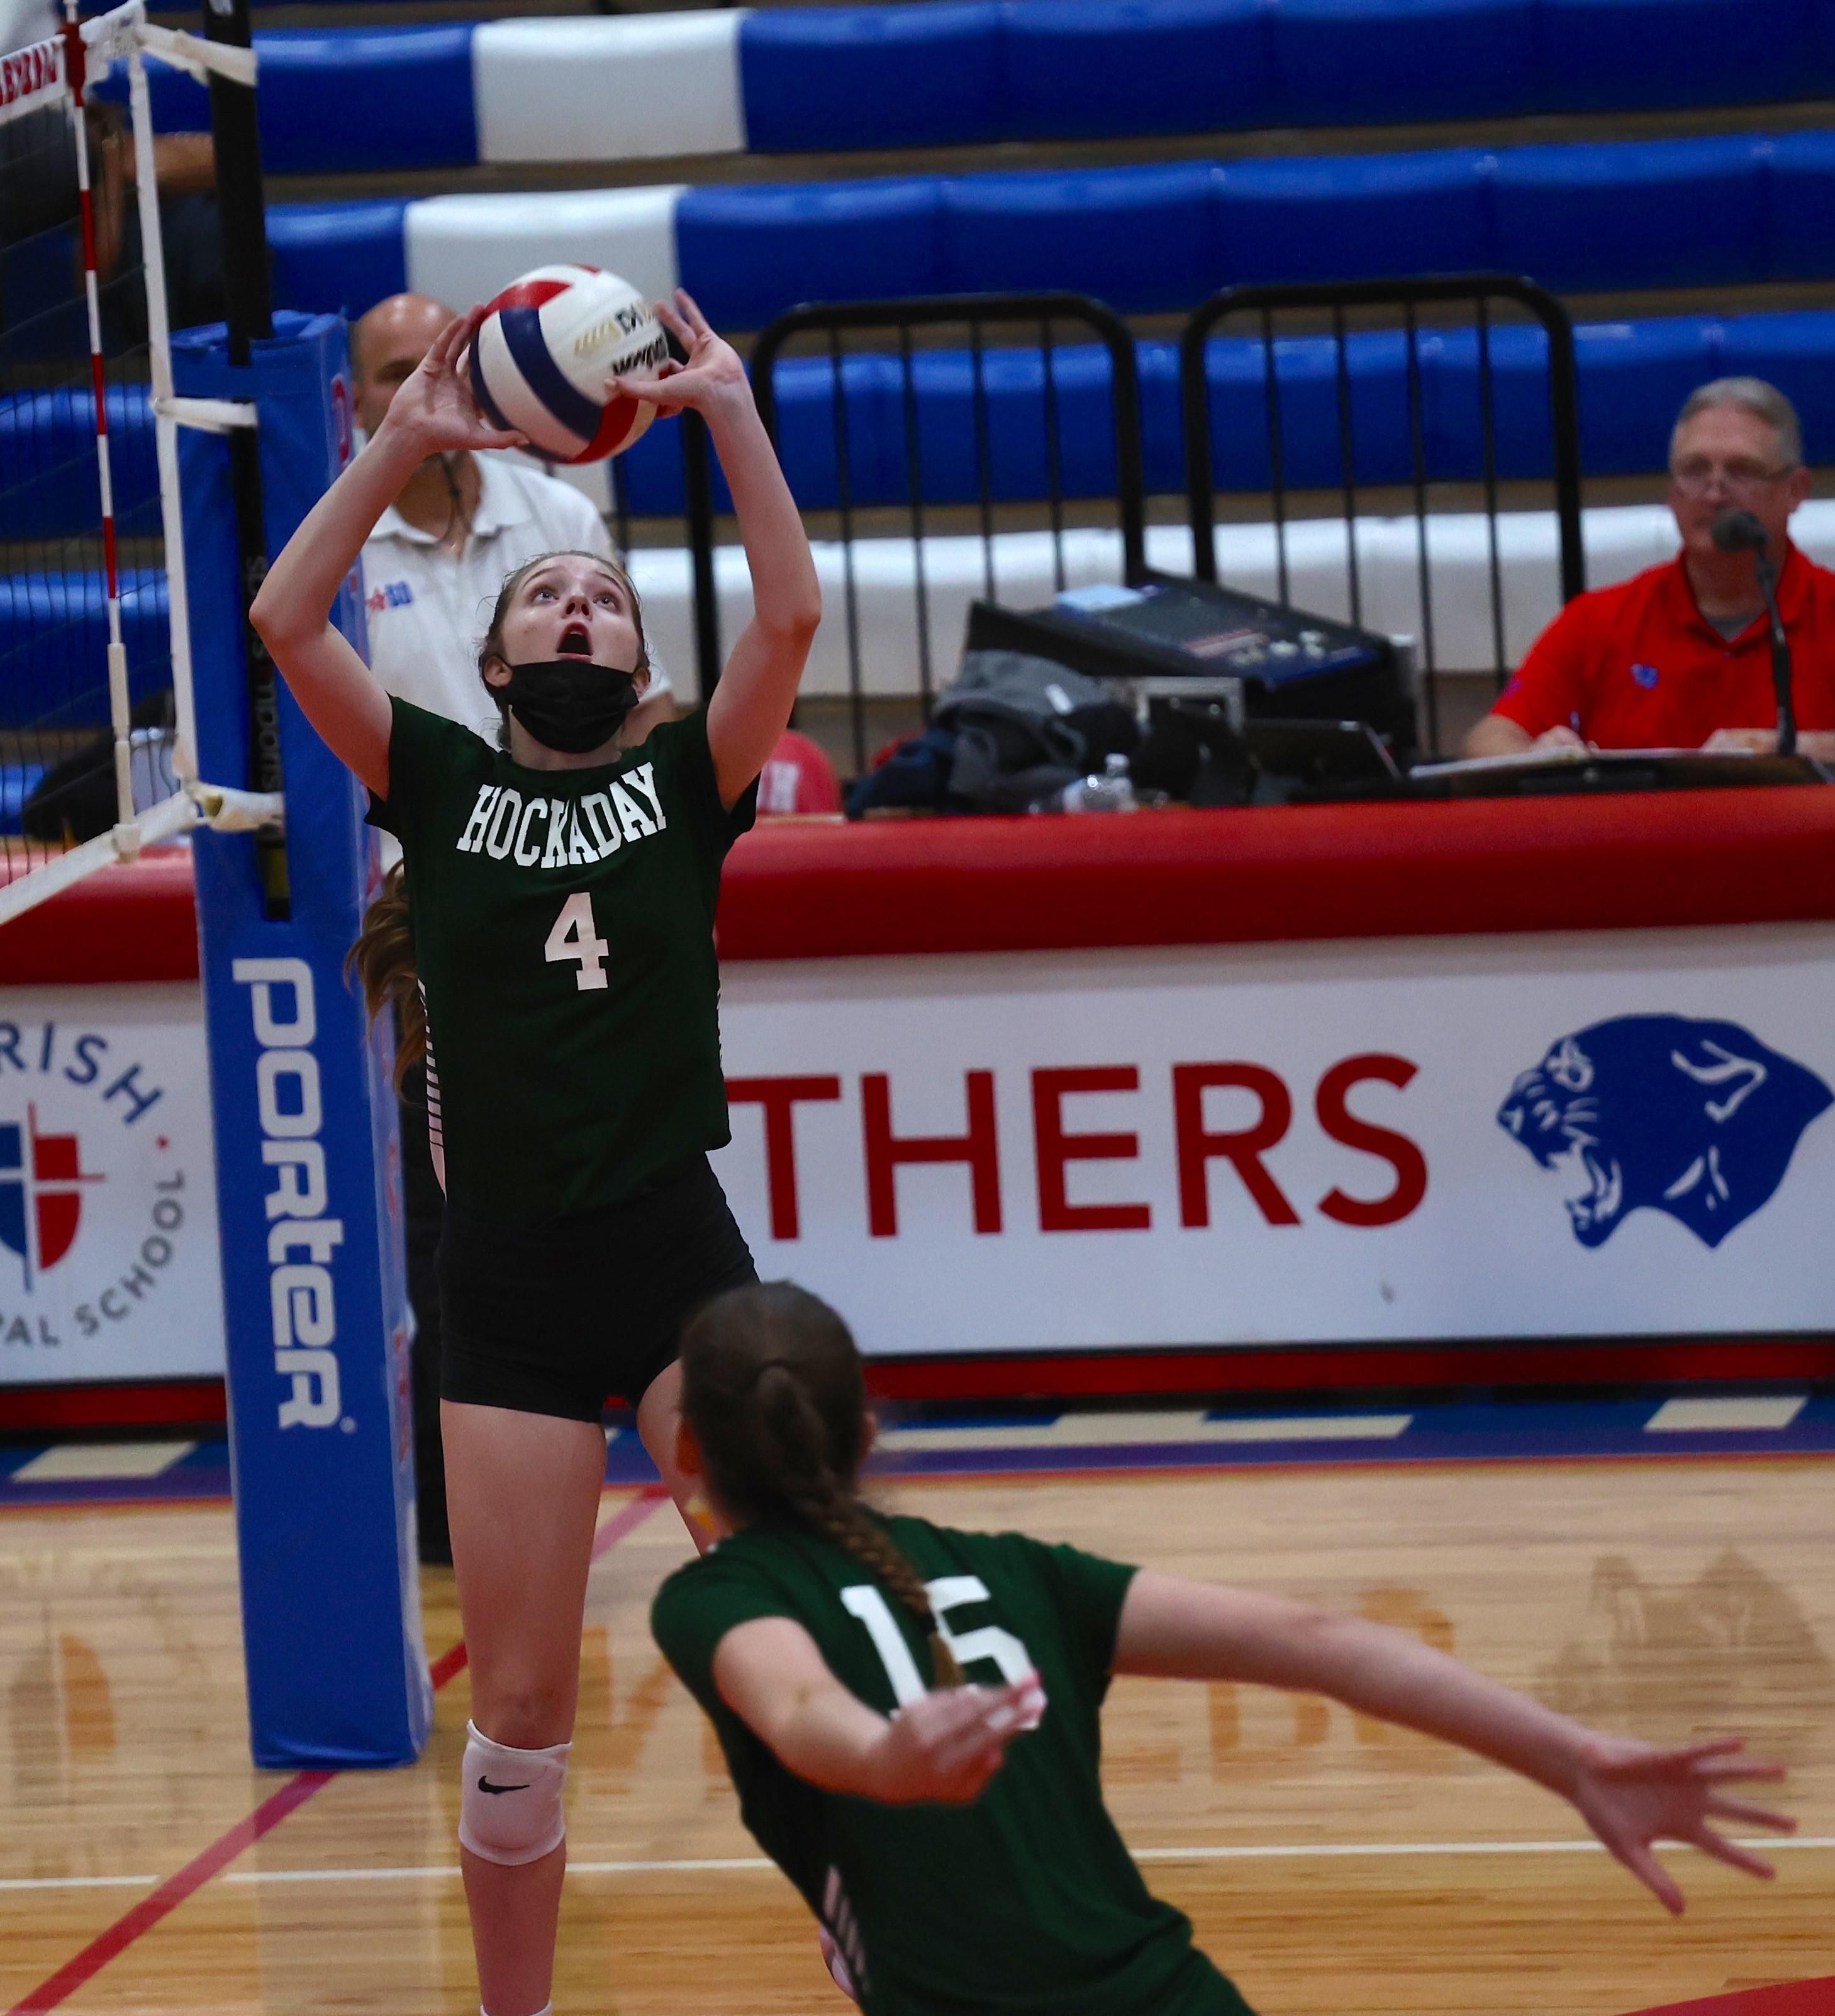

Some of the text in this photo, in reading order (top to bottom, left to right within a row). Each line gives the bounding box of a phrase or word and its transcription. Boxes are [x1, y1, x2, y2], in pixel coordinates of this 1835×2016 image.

[457, 762, 667, 869] HOCKADAY
[544, 891, 610, 991] 4
[0, 1168, 185, 1348] AL SCHOOL
[839, 1575, 1035, 1720] 15
